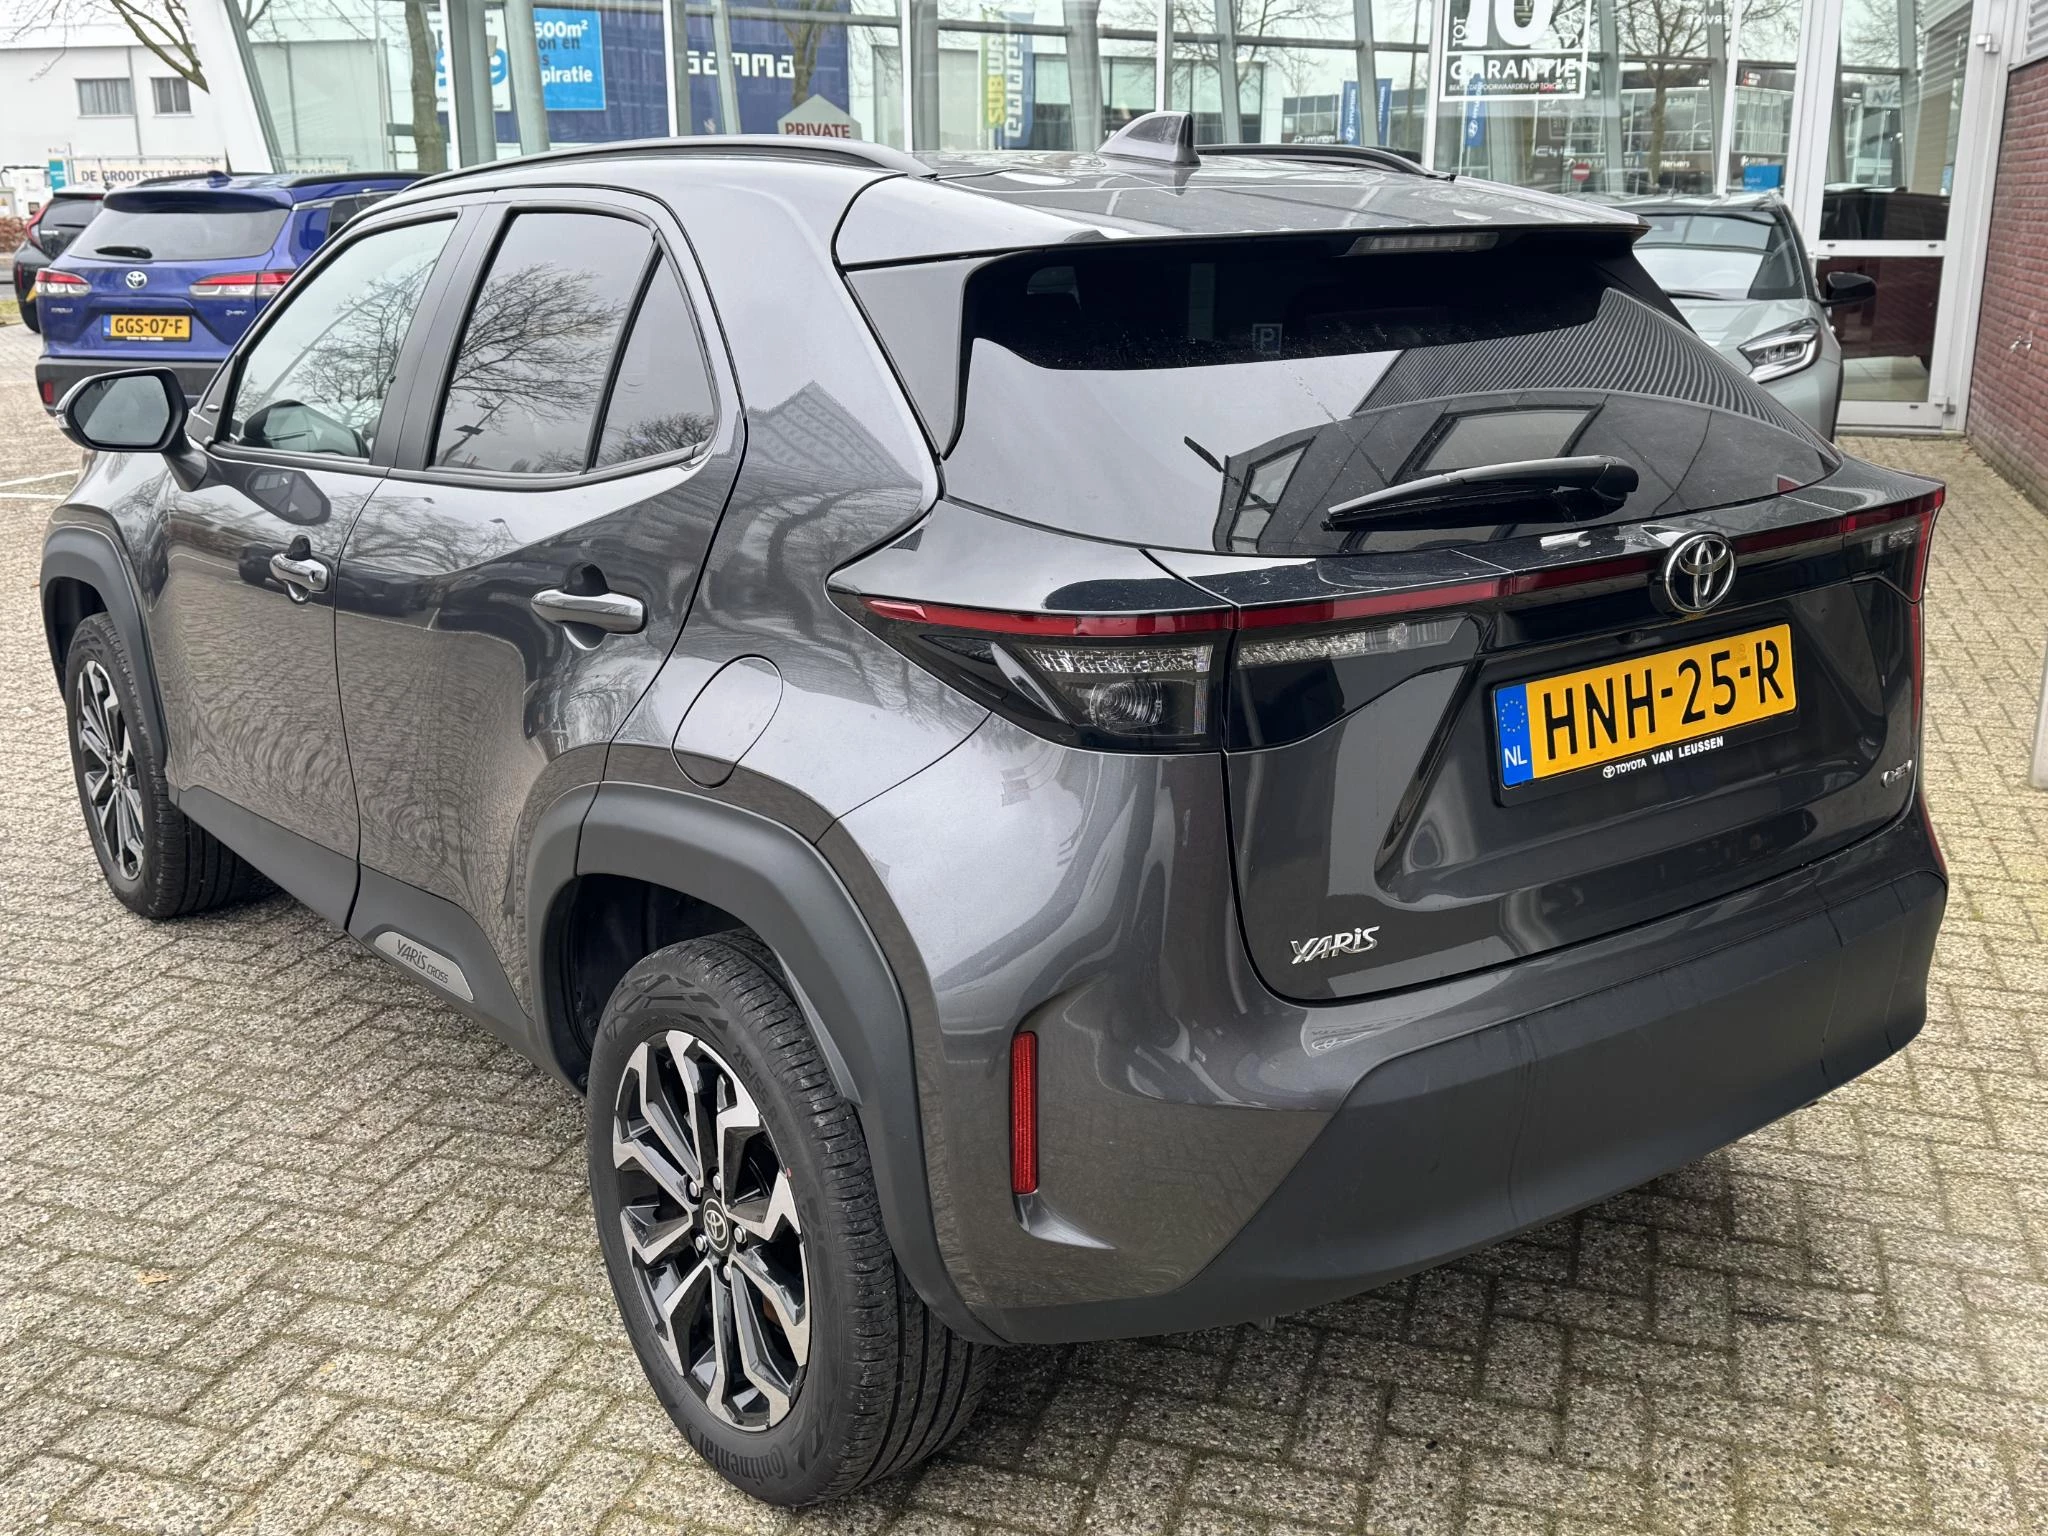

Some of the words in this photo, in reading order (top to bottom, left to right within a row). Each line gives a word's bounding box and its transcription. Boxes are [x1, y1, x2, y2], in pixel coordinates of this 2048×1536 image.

[1452, 16, 1466, 47] TOT
[987, 33, 1005, 126] SUBWA
[785, 122, 850, 138] PRIVATE
[81, 170, 97, 182] DE
[115, 318, 183, 334] GGS-07-F
[1543, 639, 1785, 761] HNH-25-R
[1504, 744, 1528, 769] NL
[1615, 757, 1647, 774] TOYOTA
[1651, 749, 1674, 765] VAN
[1678, 736, 1724, 758] LEUSSEN
[426, 963, 449, 984] CROSS
[700, 1432, 789, 1488] Continental
